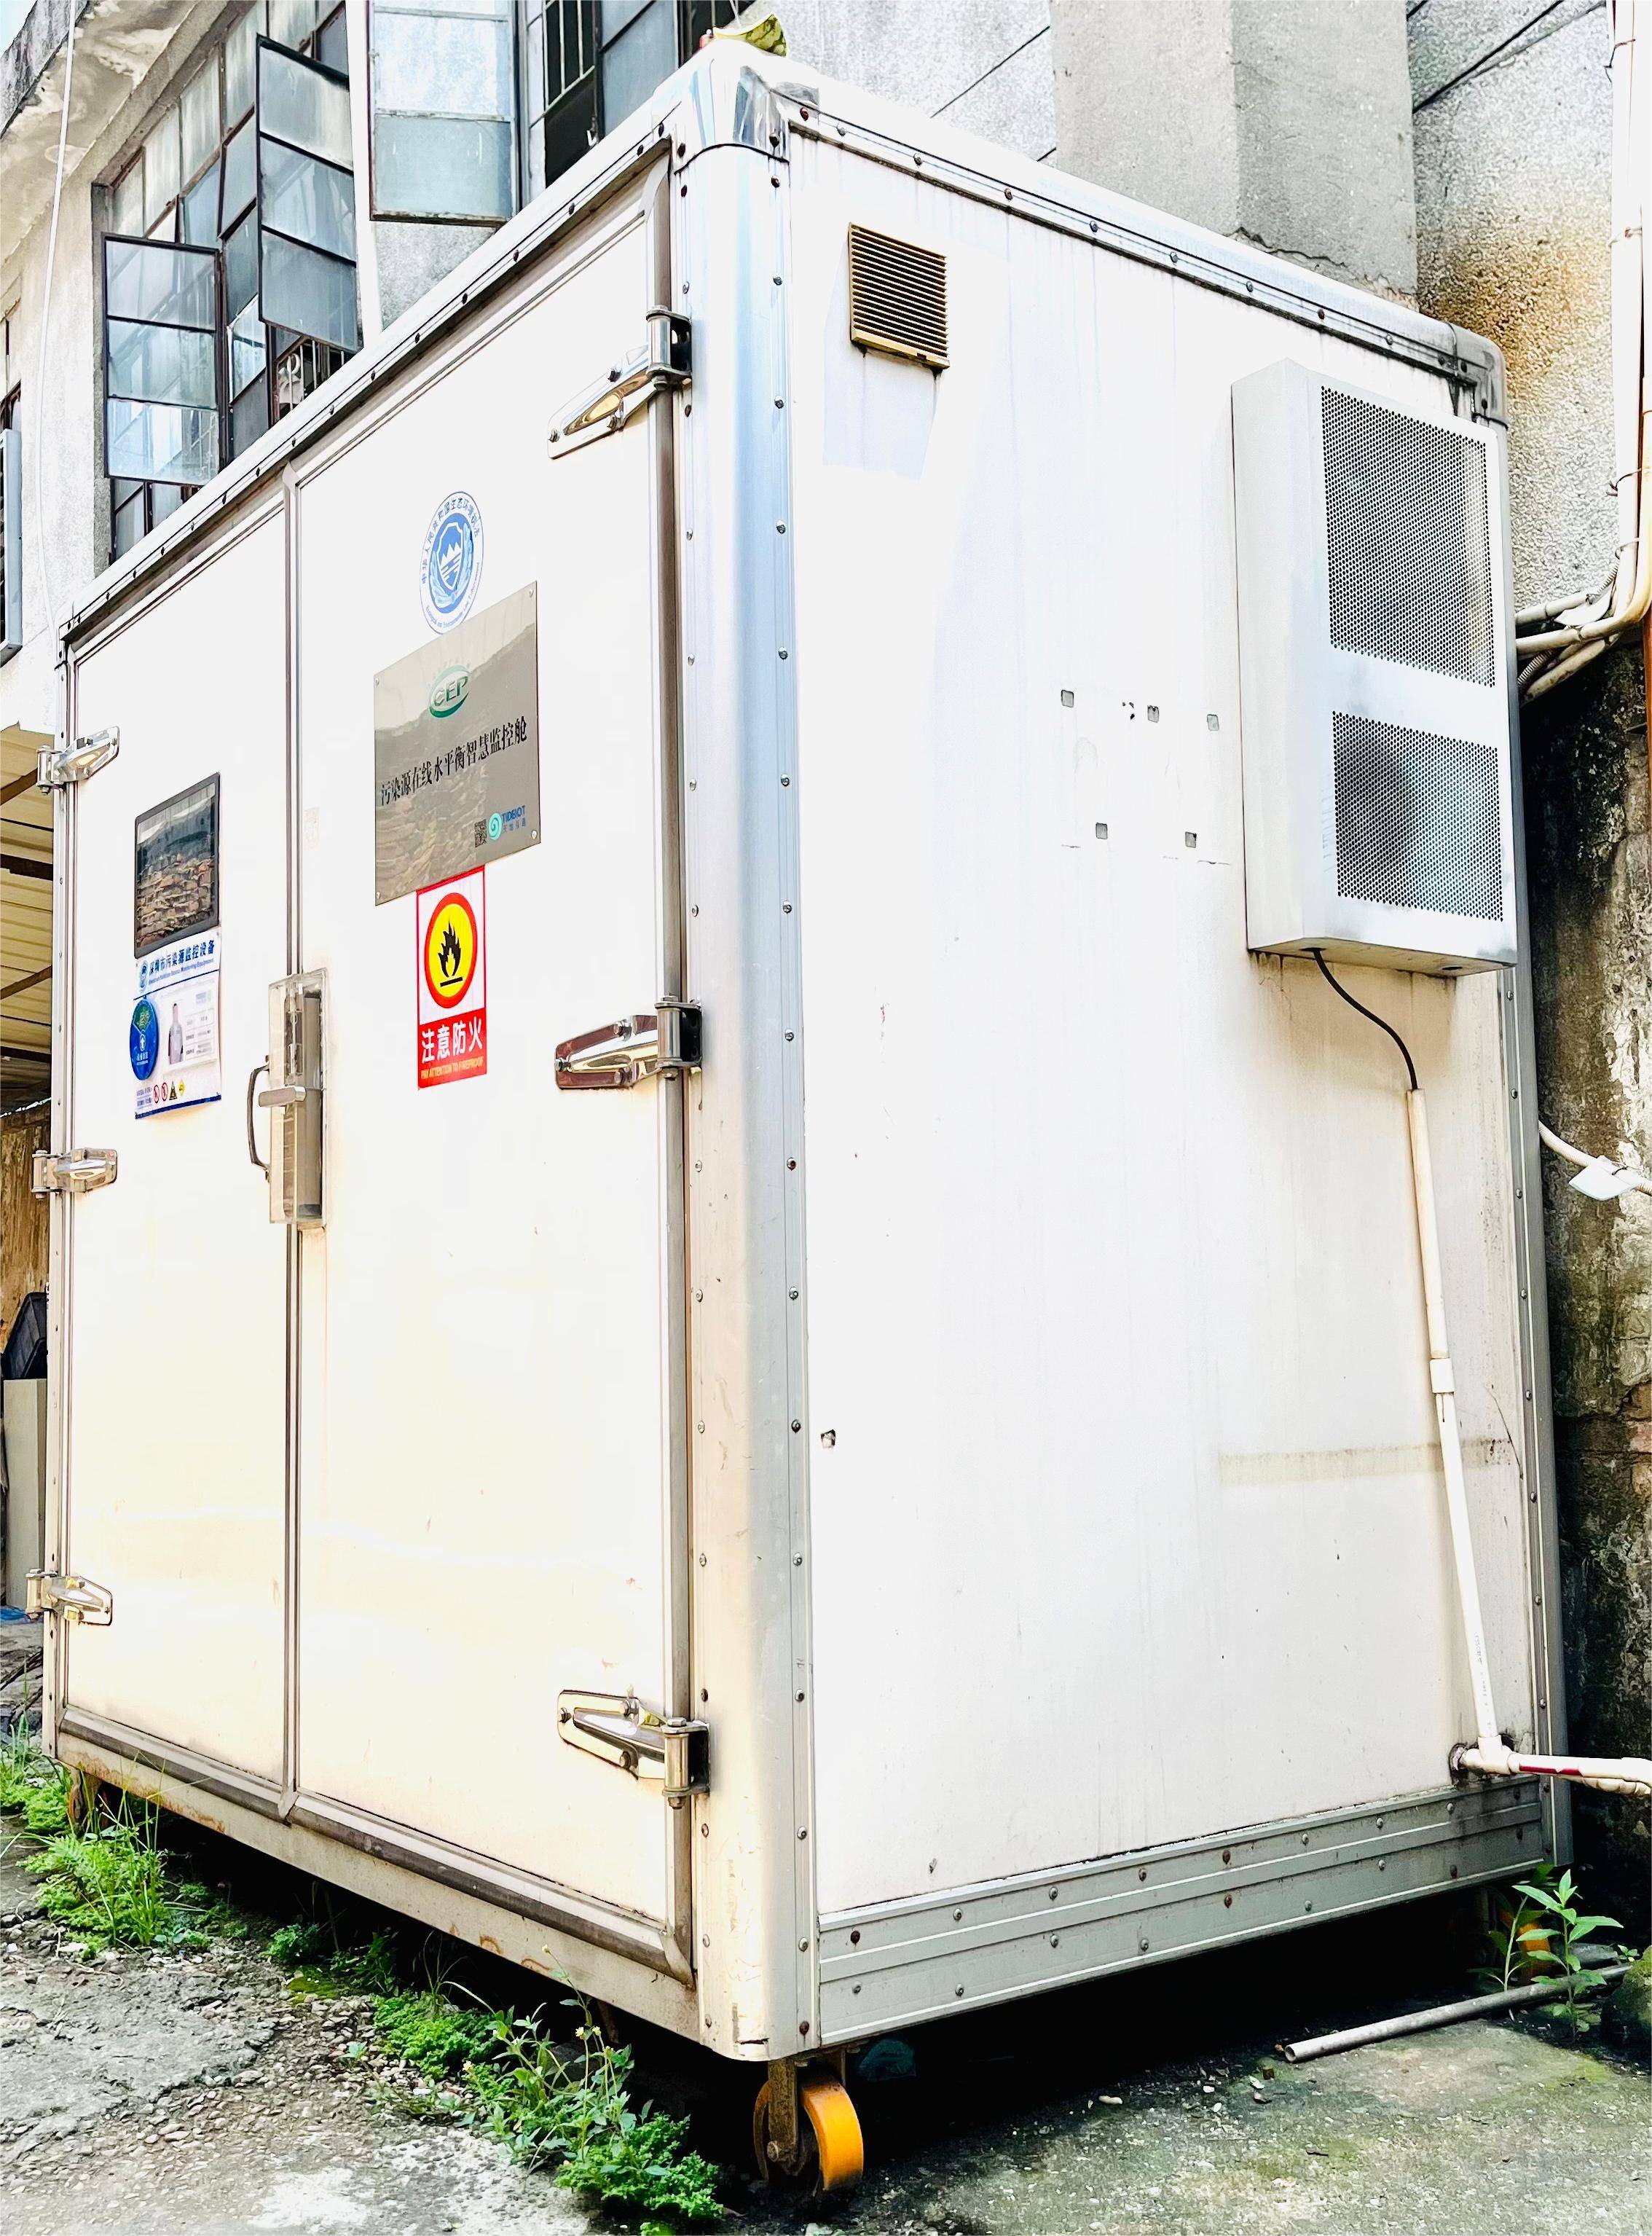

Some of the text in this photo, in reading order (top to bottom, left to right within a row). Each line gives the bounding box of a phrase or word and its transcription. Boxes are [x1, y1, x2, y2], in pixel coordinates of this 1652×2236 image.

[434, 675, 468, 707] CEP
[381, 715, 527, 806] 污染源在线水平衡智慧监控舱
[149, 939, 215, 976] 深圳市污染源监控设备
[422, 1016, 483, 1064] 注意防火
[459, 1056, 484, 1070] FIREPROOF
